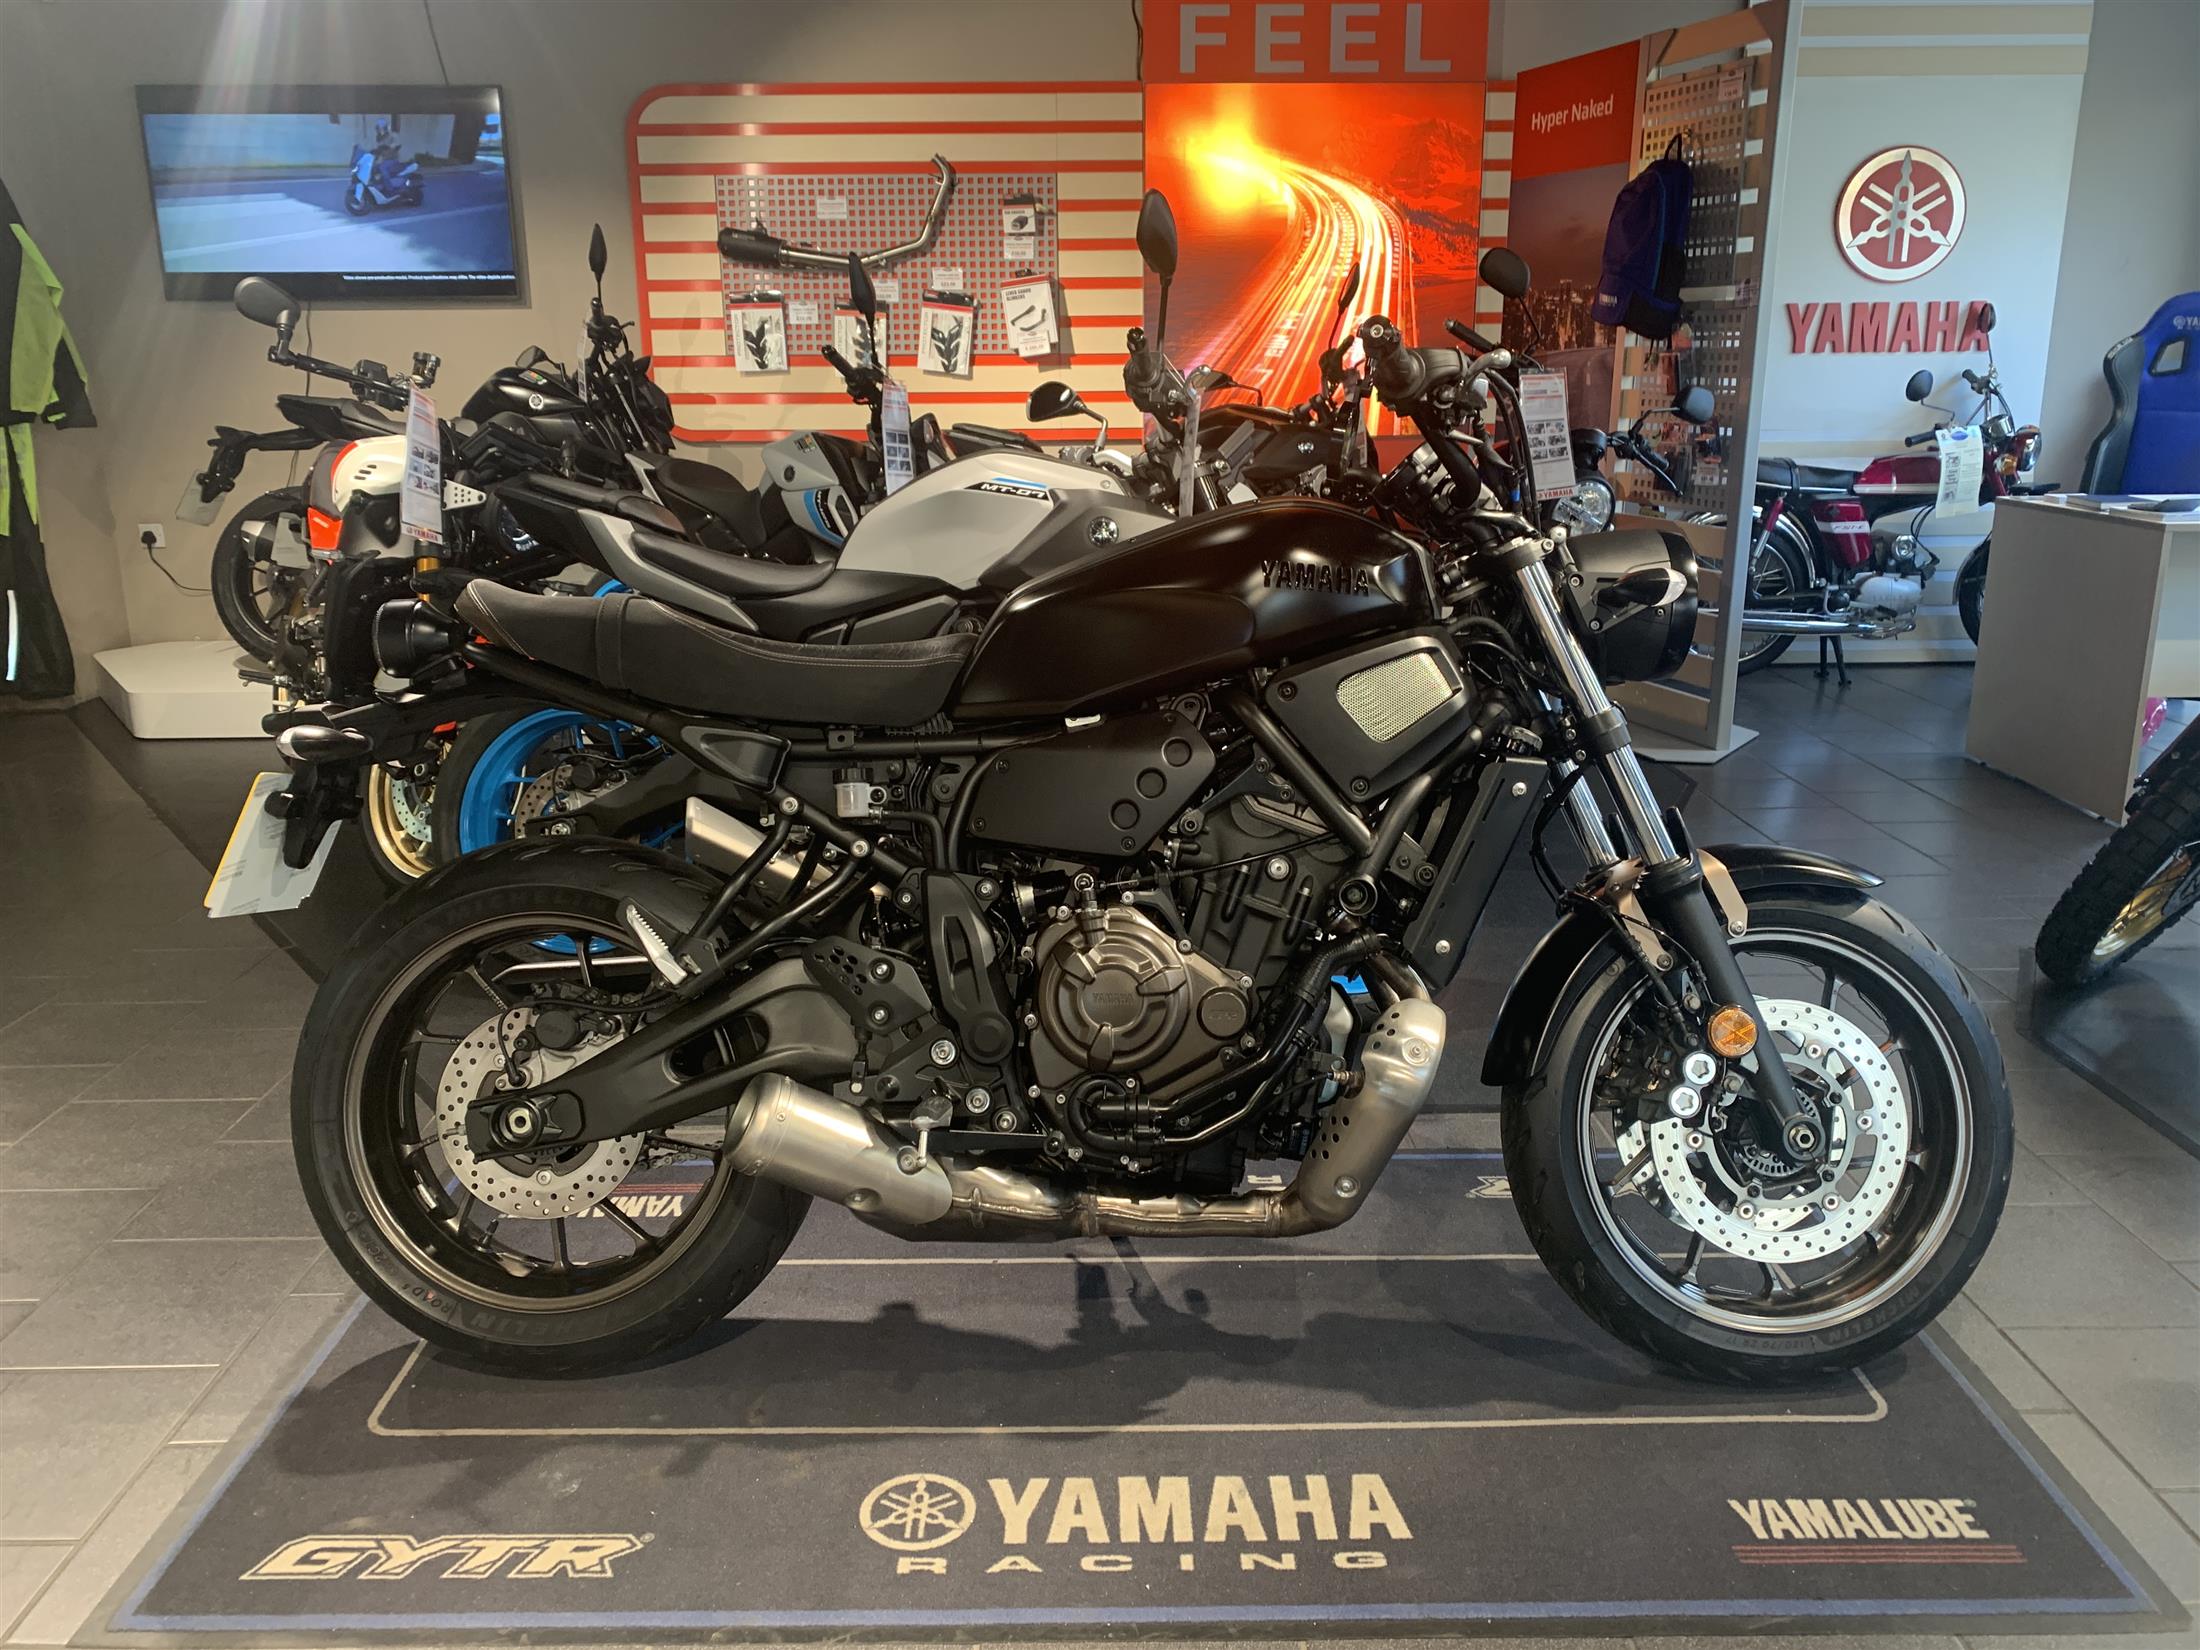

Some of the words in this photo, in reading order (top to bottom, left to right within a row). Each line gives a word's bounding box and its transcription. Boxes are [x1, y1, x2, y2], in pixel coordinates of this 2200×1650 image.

[1180, 4, 1451, 73] FEEL
[1531, 108, 1569, 134] Hyper
[1571, 95, 1614, 123] Naked
[1786, 301, 1989, 353] YAMAHA
[981, 483, 1046, 498] MT-07
[1543, 488, 1574, 498] YAMAHA
[1262, 560, 1369, 597] YAMAHA
[411, 1286, 453, 1314] ROAD
[987, 1473, 1414, 1545] YAMAHA
[1727, 1498, 1990, 1539] YAMALUBE
[896, 1551, 1389, 1575] RACING
